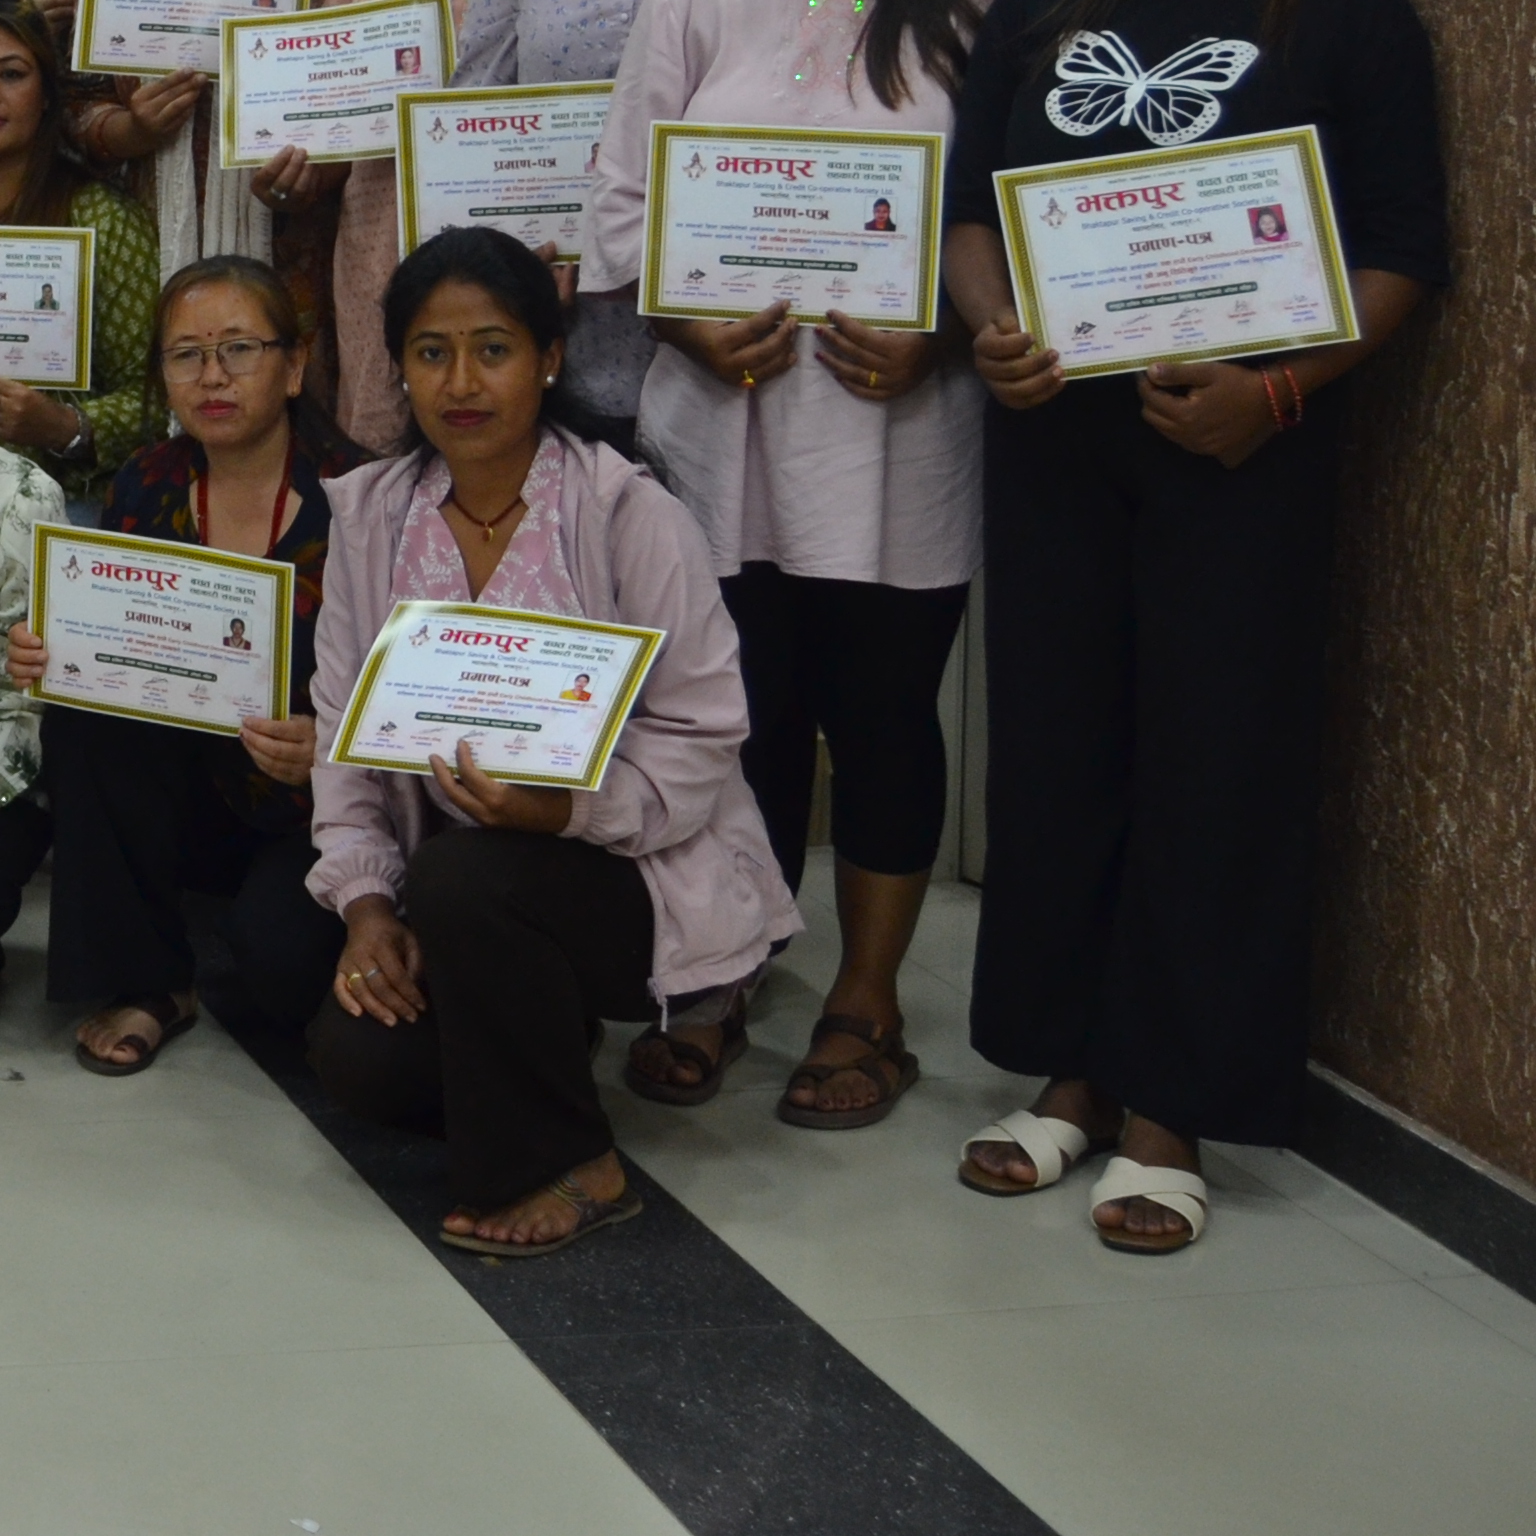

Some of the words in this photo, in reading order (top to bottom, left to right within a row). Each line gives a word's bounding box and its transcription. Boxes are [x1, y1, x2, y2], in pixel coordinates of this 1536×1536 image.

[276, 29, 355, 51] भक्तपुर
[457, 114, 543, 135] भक्तपुर
[716, 156, 817, 180] भक्तपुर
[1074, 182, 1184, 214] भक्तपुर
[92, 560, 182, 591] भक्तपुर
[440, 629, 534, 653] भक्तपुर
